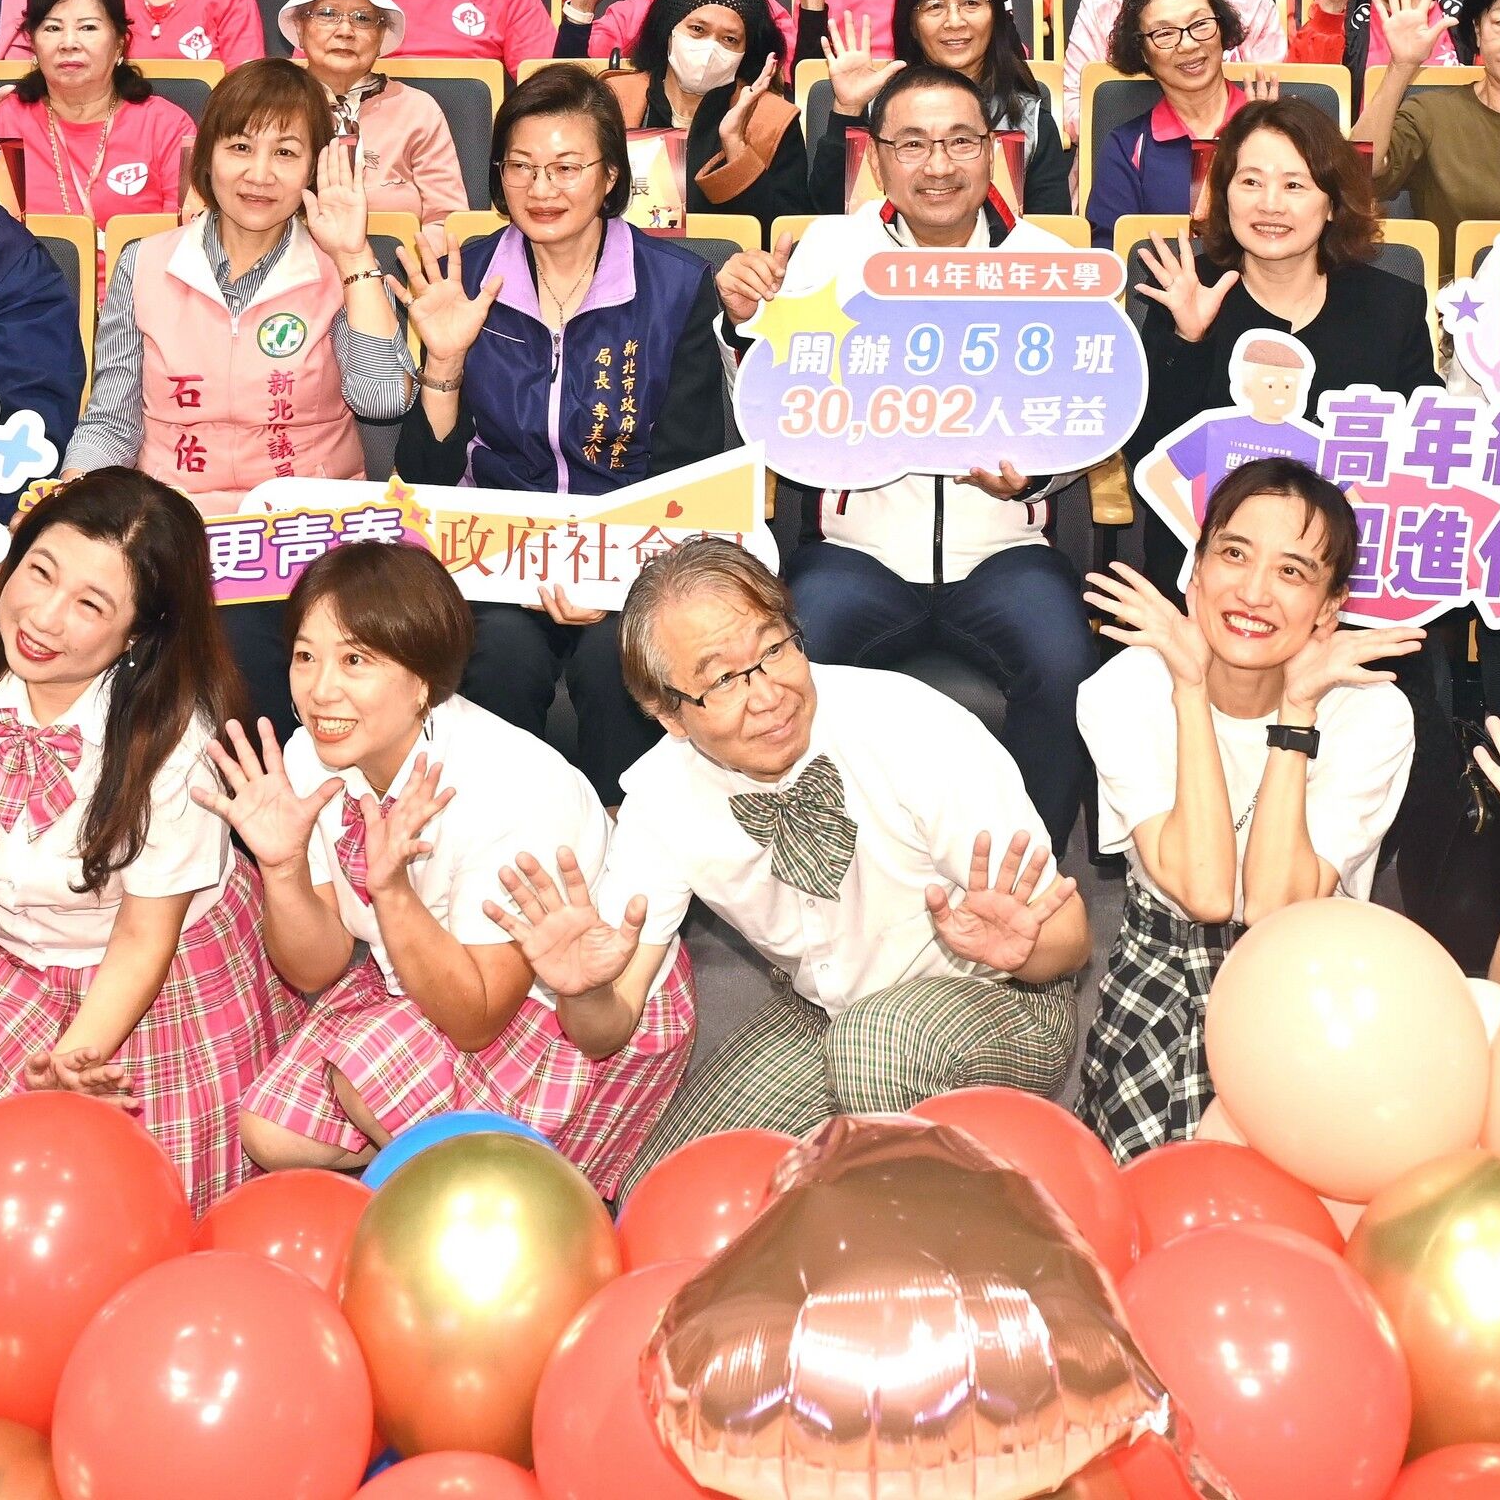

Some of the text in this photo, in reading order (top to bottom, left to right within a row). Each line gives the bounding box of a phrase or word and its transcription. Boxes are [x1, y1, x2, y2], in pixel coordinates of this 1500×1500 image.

[884, 262, 1101, 290] 114年松年大學
[593, 347, 612, 391] 局長
[780, 386, 1108, 440] 30,692人受益
